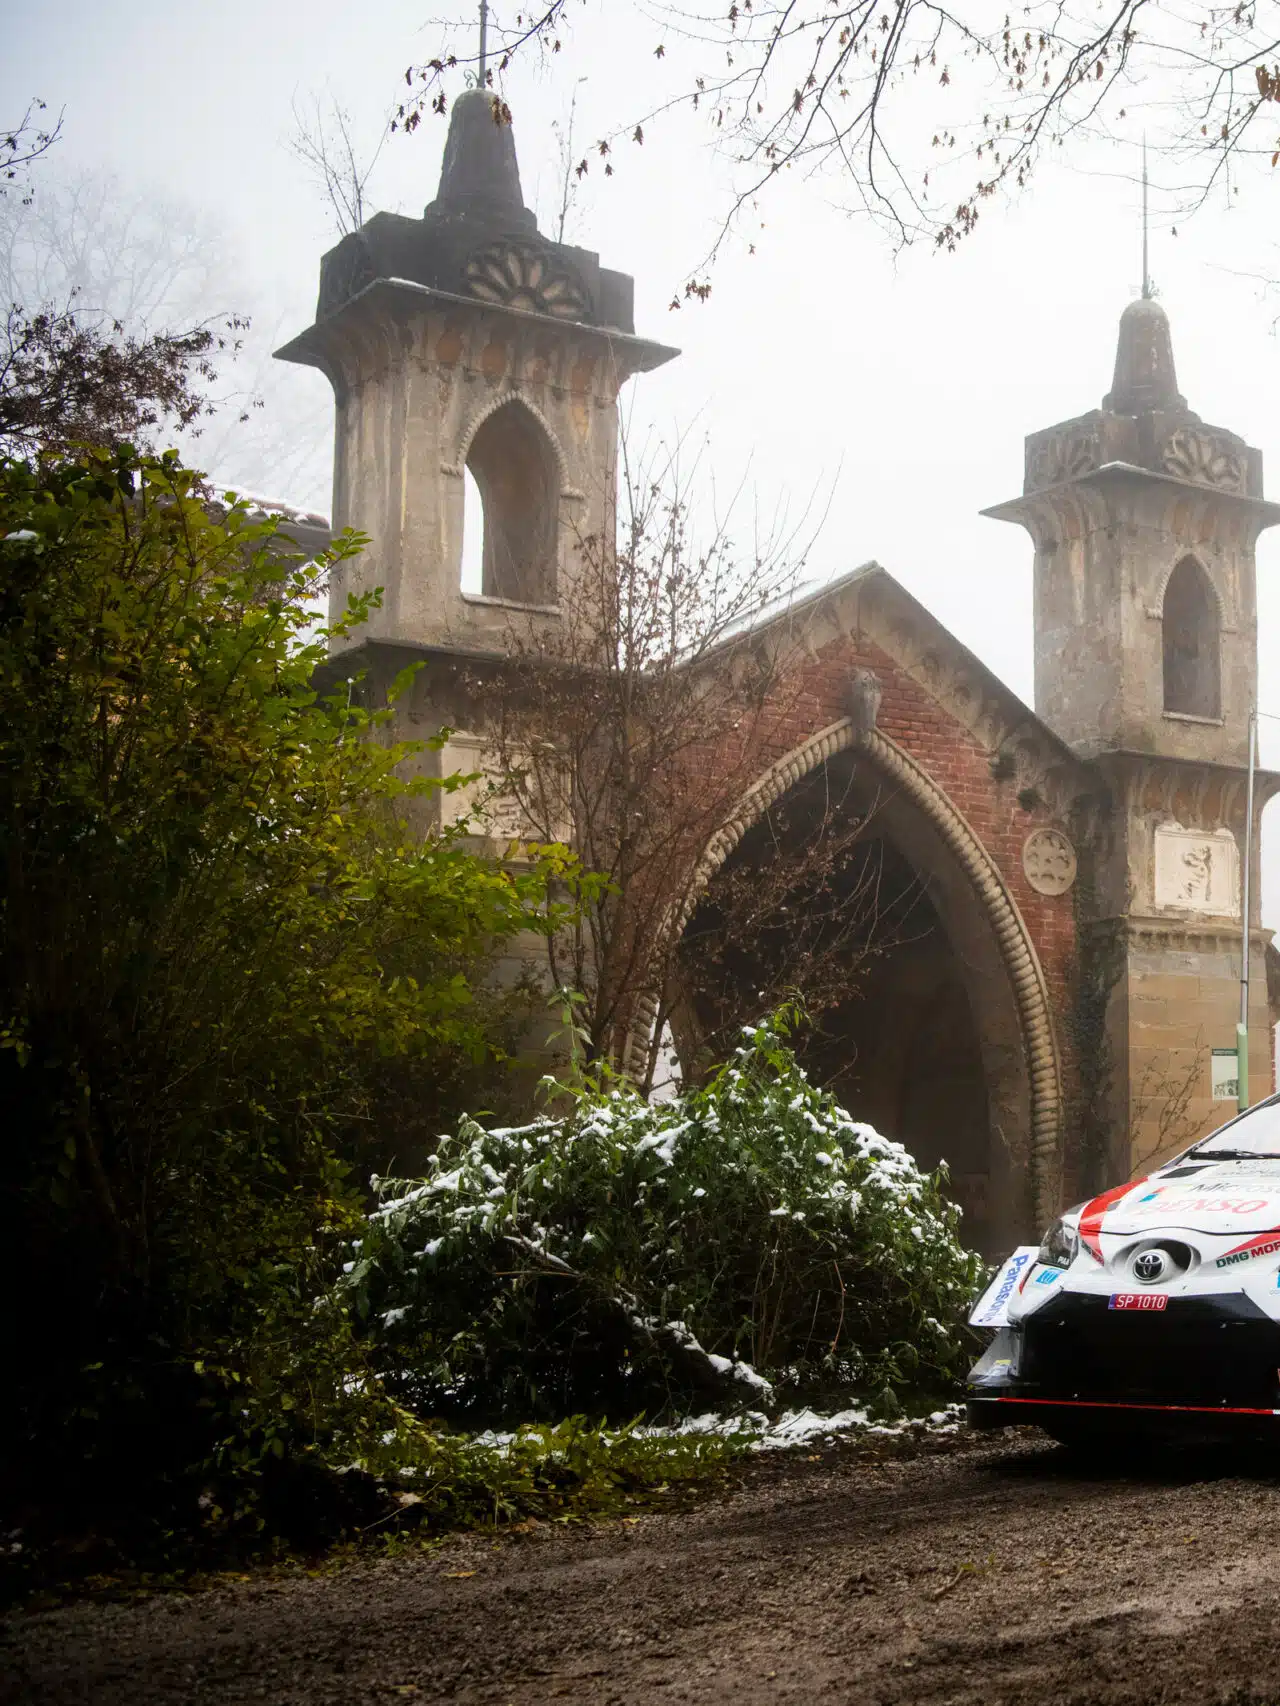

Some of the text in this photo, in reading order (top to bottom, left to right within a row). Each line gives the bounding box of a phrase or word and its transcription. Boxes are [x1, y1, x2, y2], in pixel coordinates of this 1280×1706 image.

[1215, 1251, 1250, 1268] DMG
[1116, 1295, 1165, 1309] SP 1010
